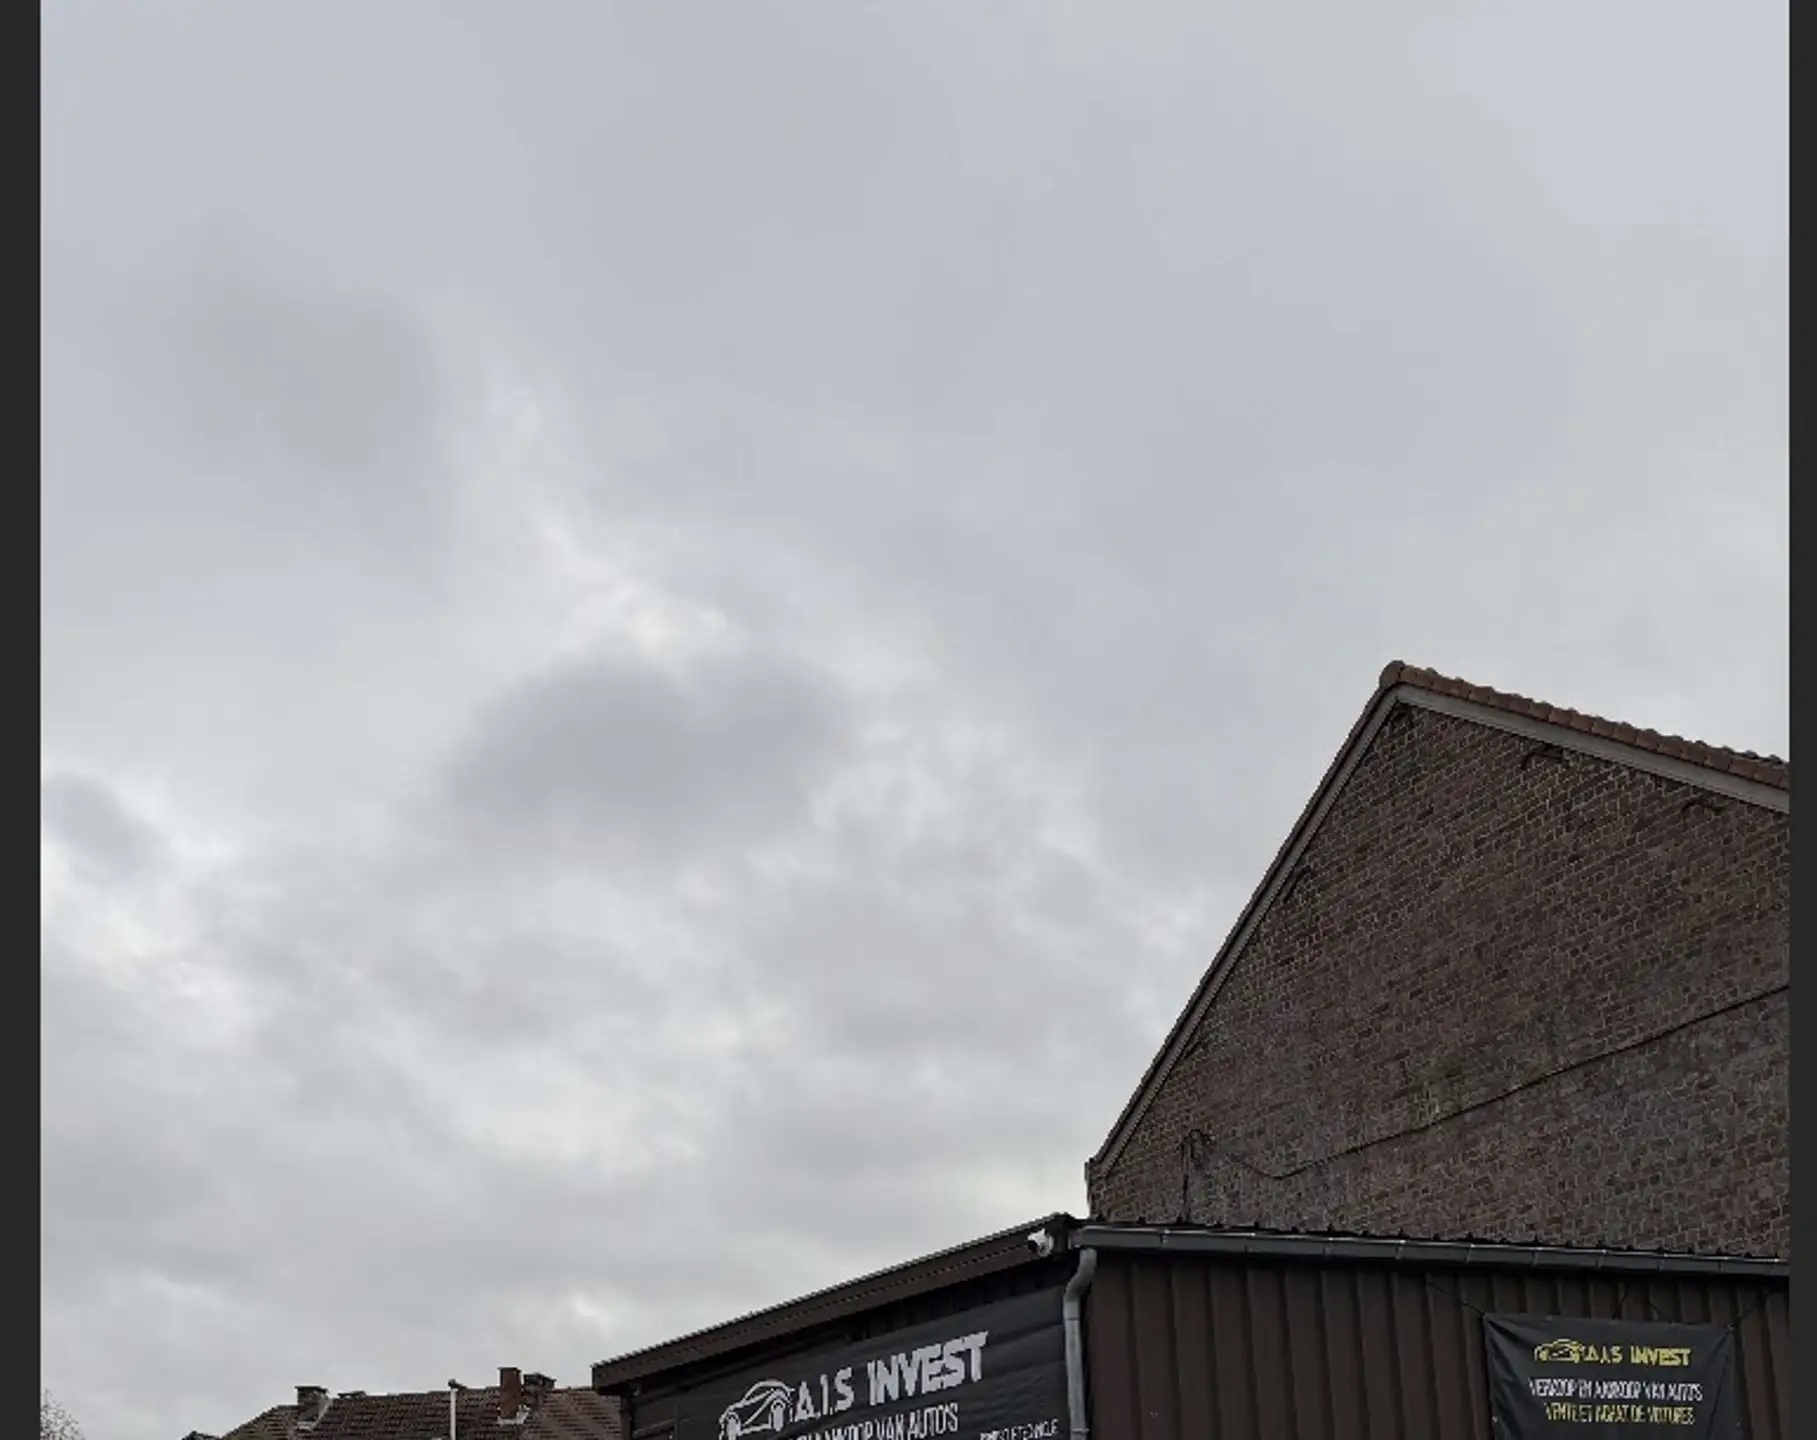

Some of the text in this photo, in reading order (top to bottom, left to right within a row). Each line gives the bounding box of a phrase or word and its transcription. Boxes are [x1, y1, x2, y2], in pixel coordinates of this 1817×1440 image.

[1630, 1345, 1691, 1366] INVEST
[791, 1331, 988, 1423] A.I.S INVEST
[1631, 1405, 1645, 1423] DE
